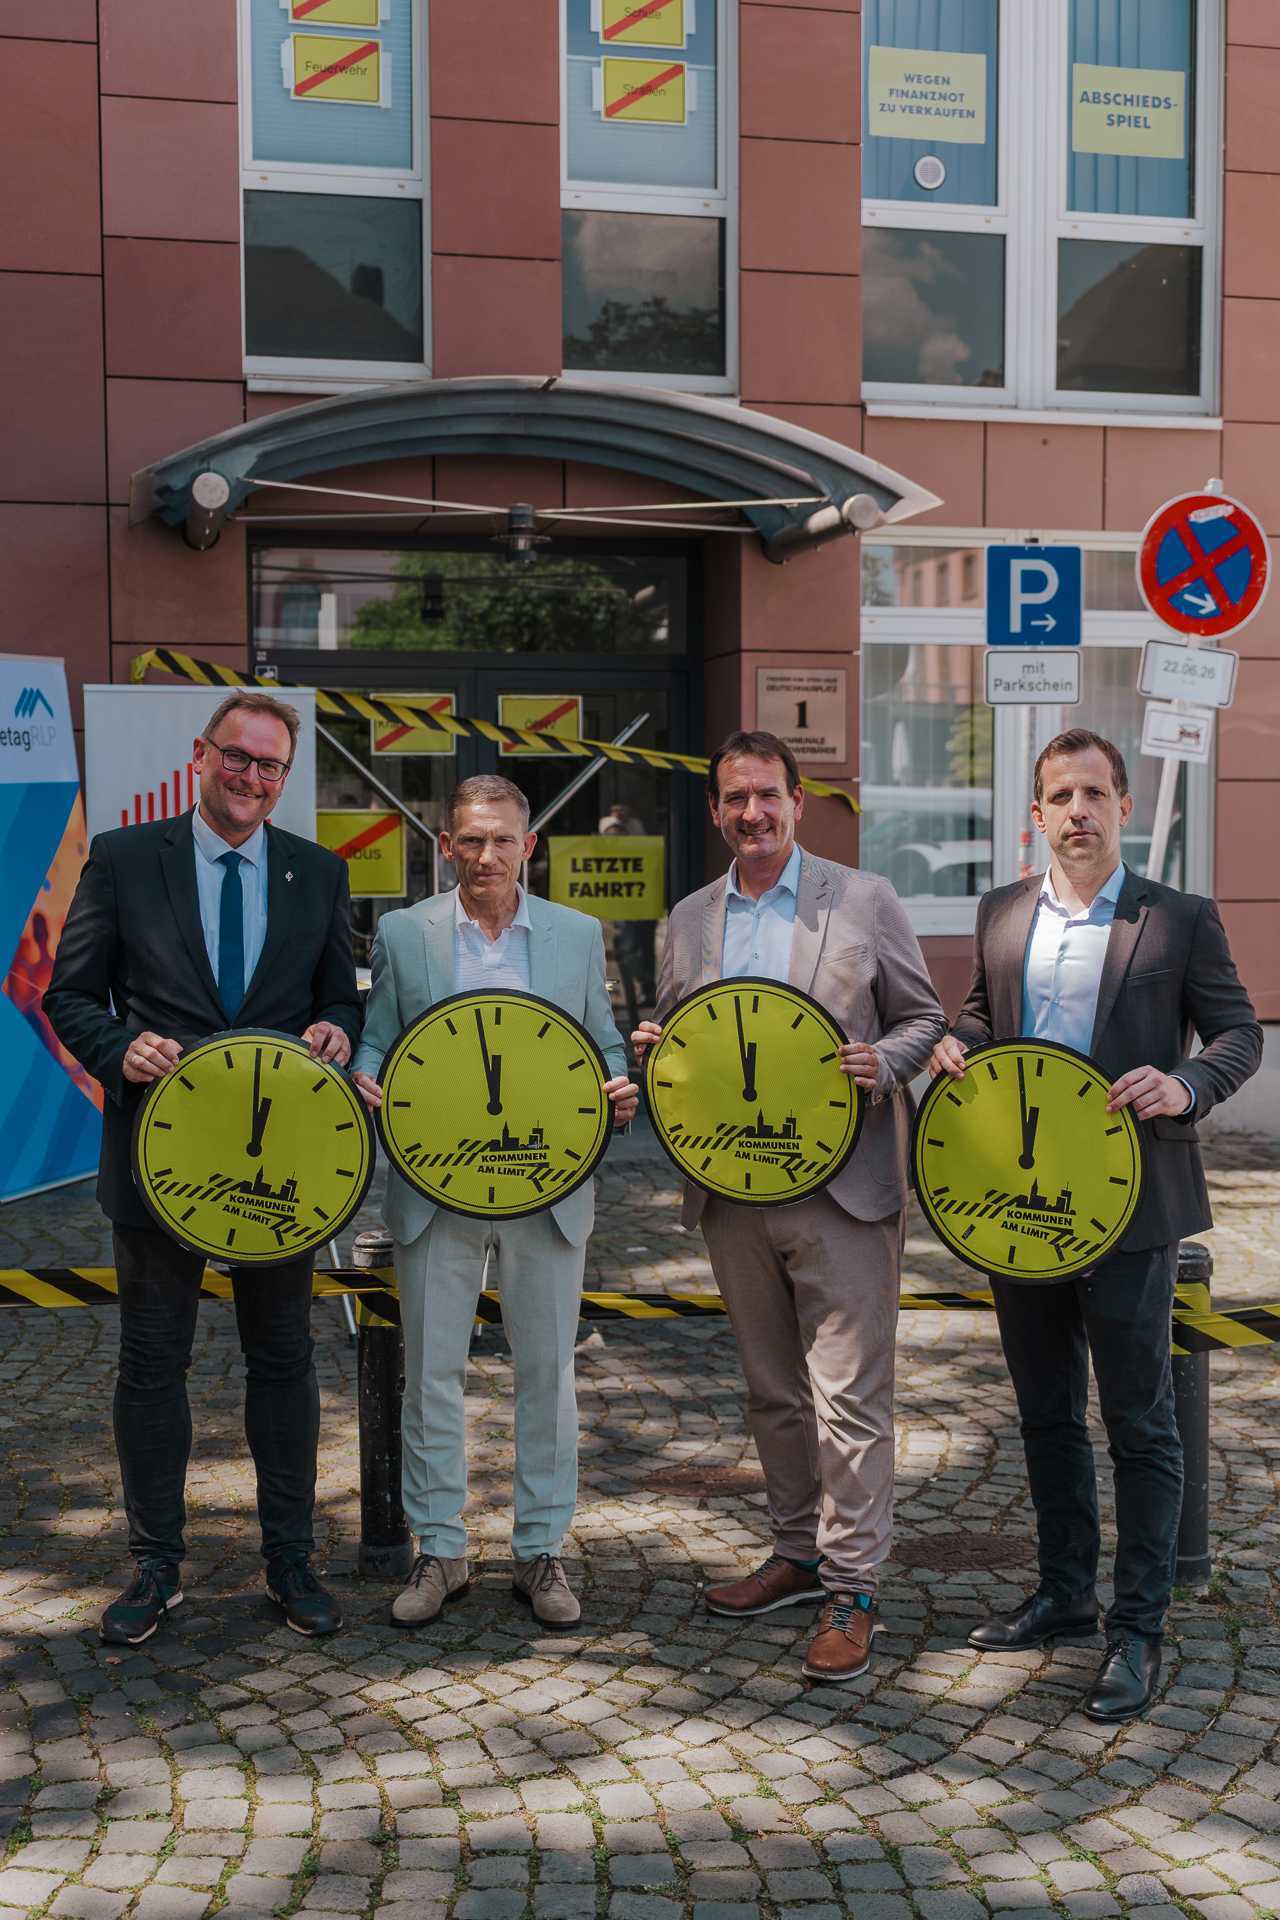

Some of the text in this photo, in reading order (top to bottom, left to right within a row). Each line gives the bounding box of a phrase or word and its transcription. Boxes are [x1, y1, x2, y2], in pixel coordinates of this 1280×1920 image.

[304, 60, 368, 76] Feuerwehr
[903, 72, 952, 86] WEGEN
[888, 87, 966, 103] FINANZNOT
[1079, 91, 1179, 110] ABSCHIEDS-
[879, 102, 977, 120] ZU VERKAUFEN
[1105, 113, 1152, 129] SPIEL
[1009, 559, 1060, 634] P
[1021, 662, 1046, 675] mit
[993, 678, 1073, 693] Parkschein
[794, 699, 809, 729] 1
[570, 856, 645, 874] LETZTE
[568, 880, 646, 898] FAHRT?
[738, 1140, 800, 1150] KOMMUNEN
[481, 1152, 547, 1163] KOMMUNEN
[734, 1150, 780, 1165] AM LIMIT
[477, 1165, 526, 1176] AM LIMIT
[229, 1193, 296, 1213] KOMMUNEN
[222, 1203, 272, 1225] AM LIMIT
[1006, 1209, 1073, 1226] KOMMUNEN
[1001, 1220, 1050, 1240] AM LIMIT
